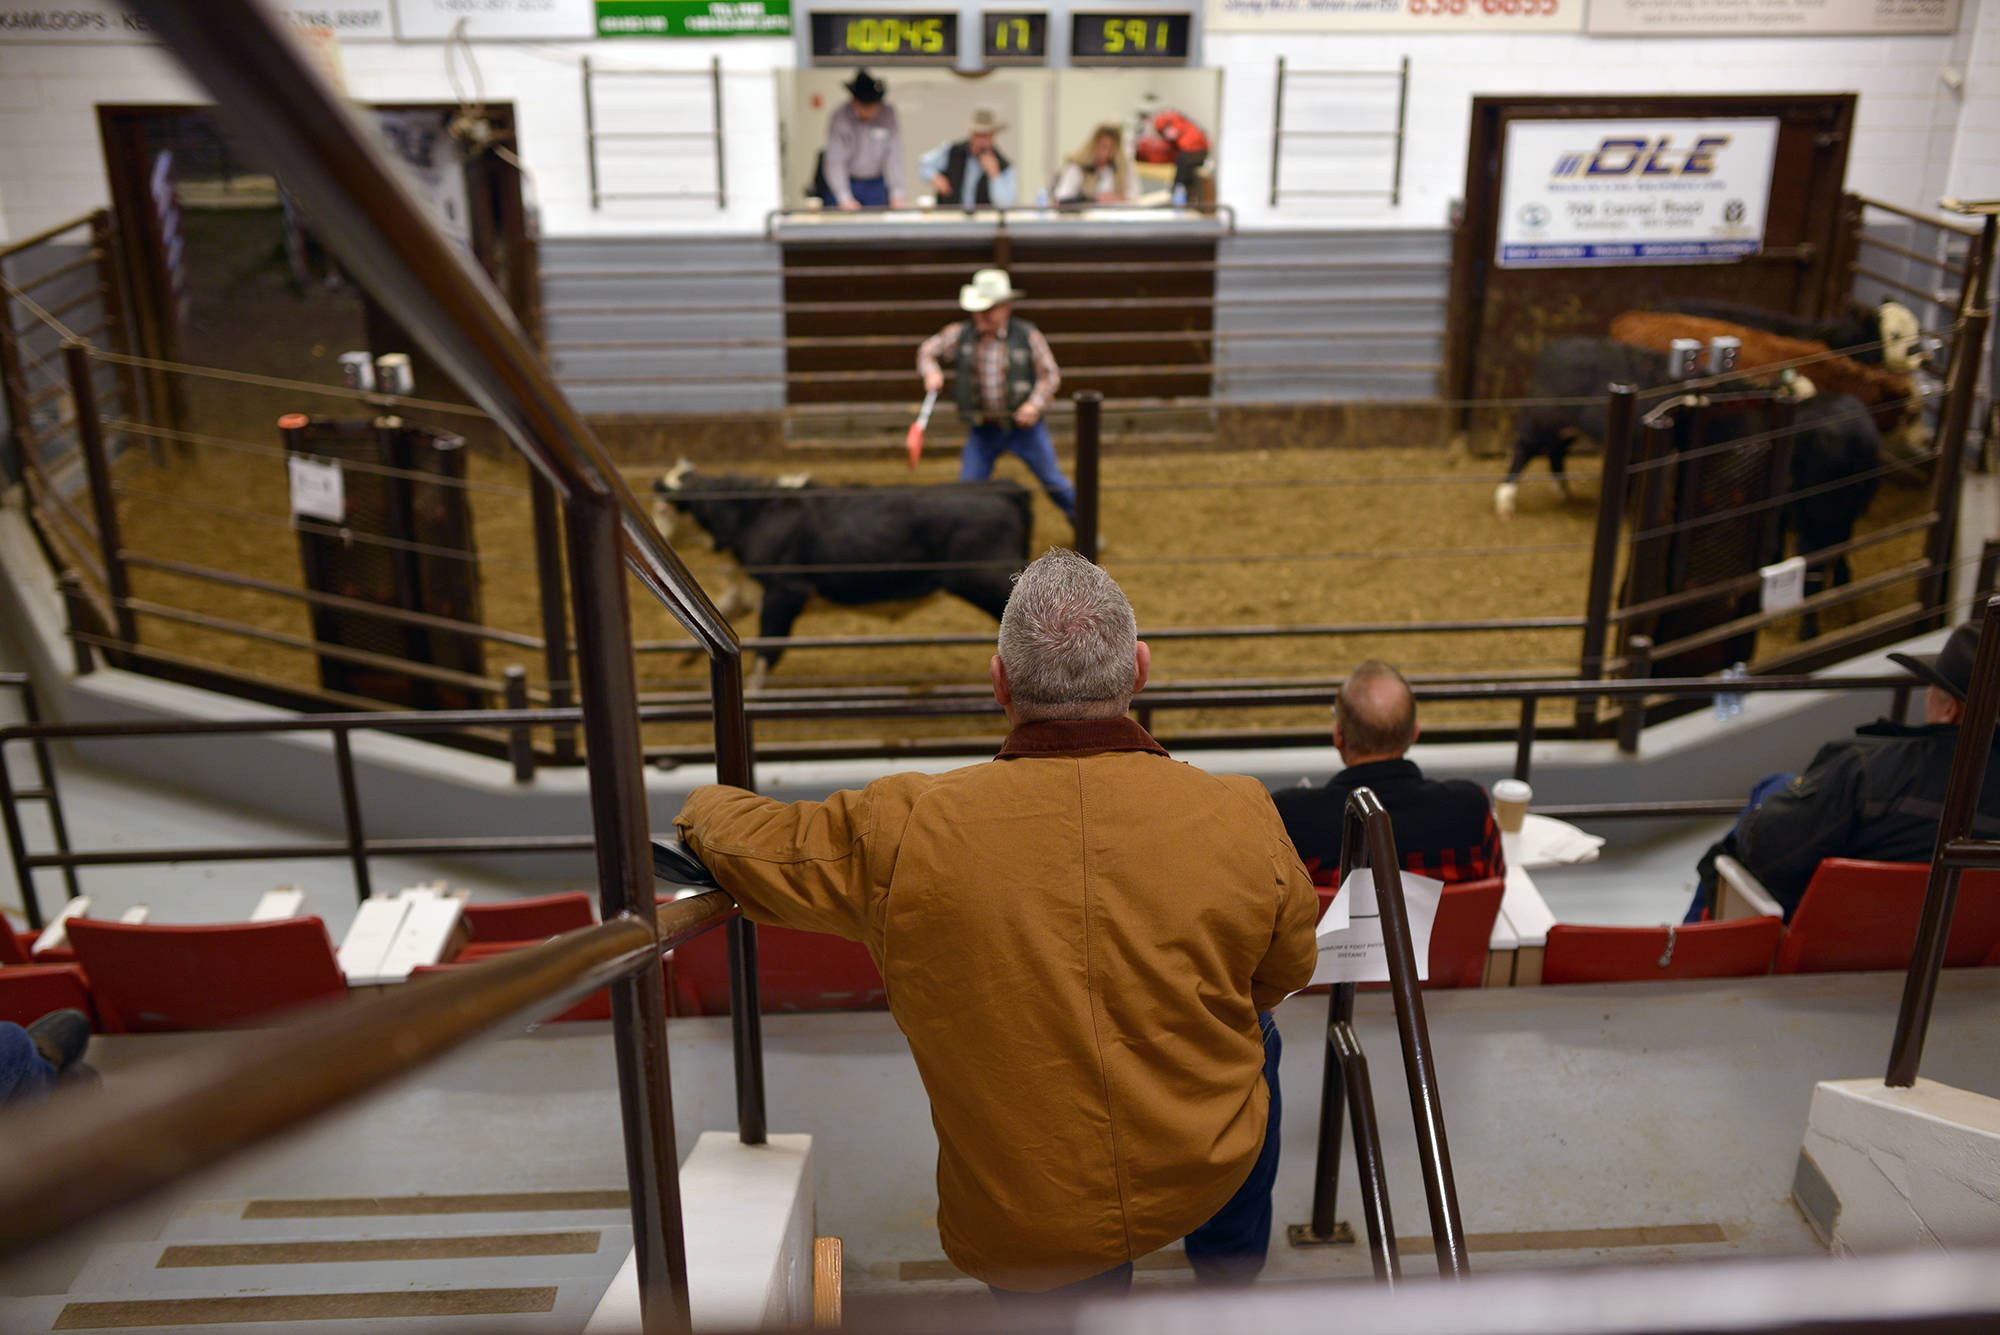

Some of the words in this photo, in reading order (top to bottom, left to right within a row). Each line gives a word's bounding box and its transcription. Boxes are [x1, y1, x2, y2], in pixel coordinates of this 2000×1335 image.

[846, 18, 943, 52] 10045
[996, 19, 1030, 51] 17
[1103, 18, 1168, 52] 591
